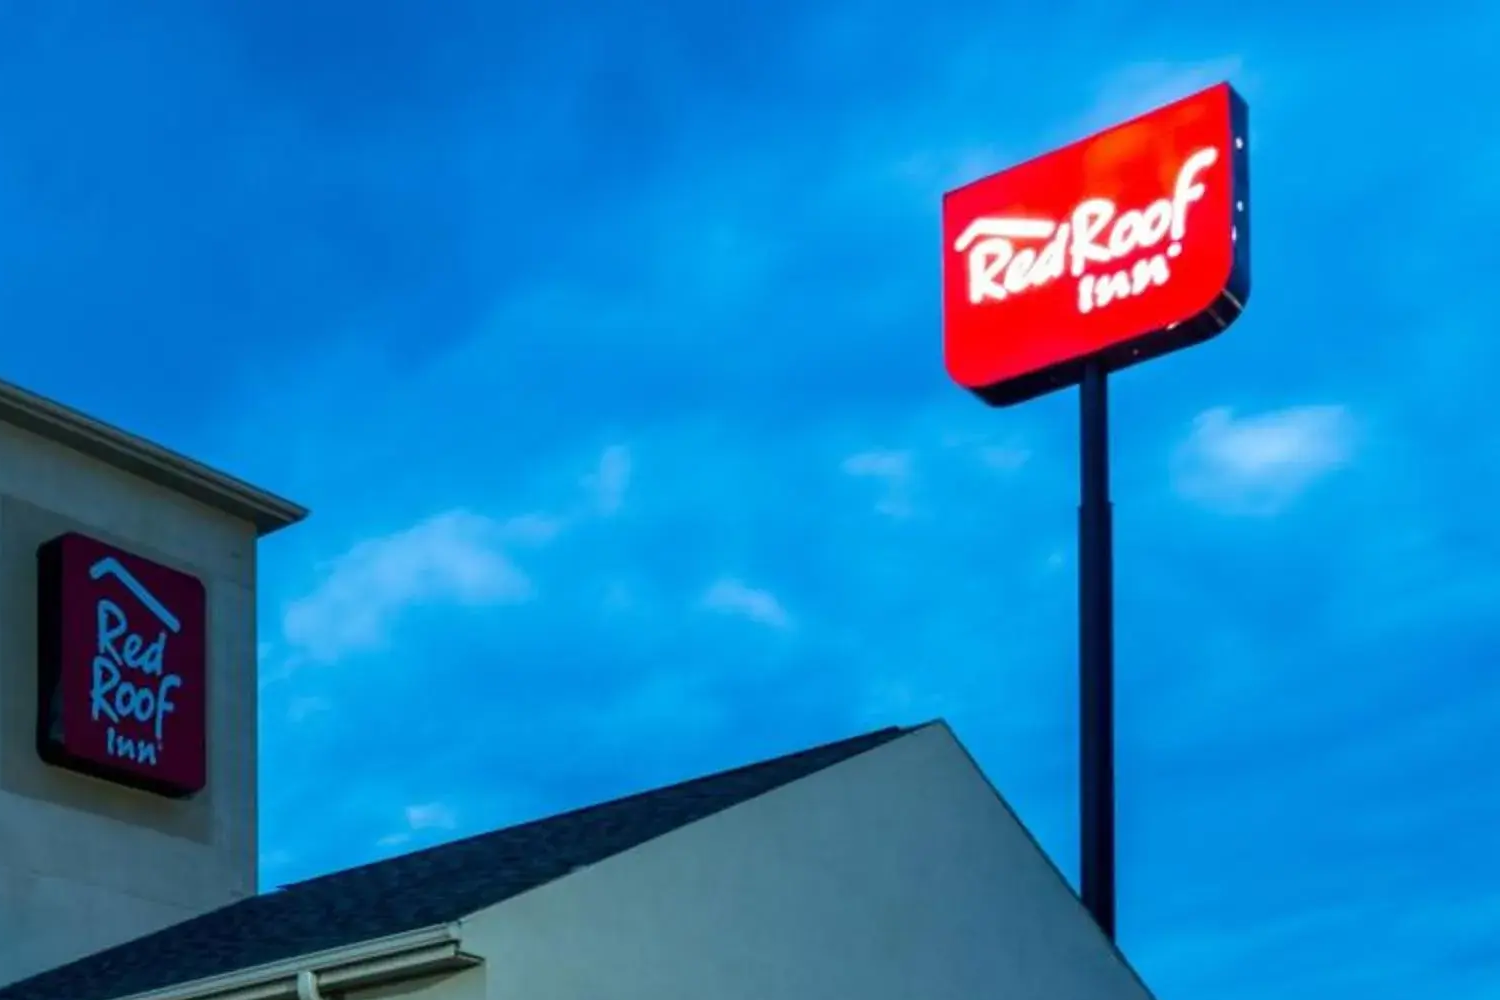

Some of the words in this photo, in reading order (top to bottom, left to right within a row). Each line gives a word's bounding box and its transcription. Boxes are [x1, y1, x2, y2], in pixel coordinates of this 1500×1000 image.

[1078, 253, 1170, 313] Inn
[97, 599, 167, 676] Red
[90, 655, 182, 740] Roof
[106, 727, 158, 766] Inn
